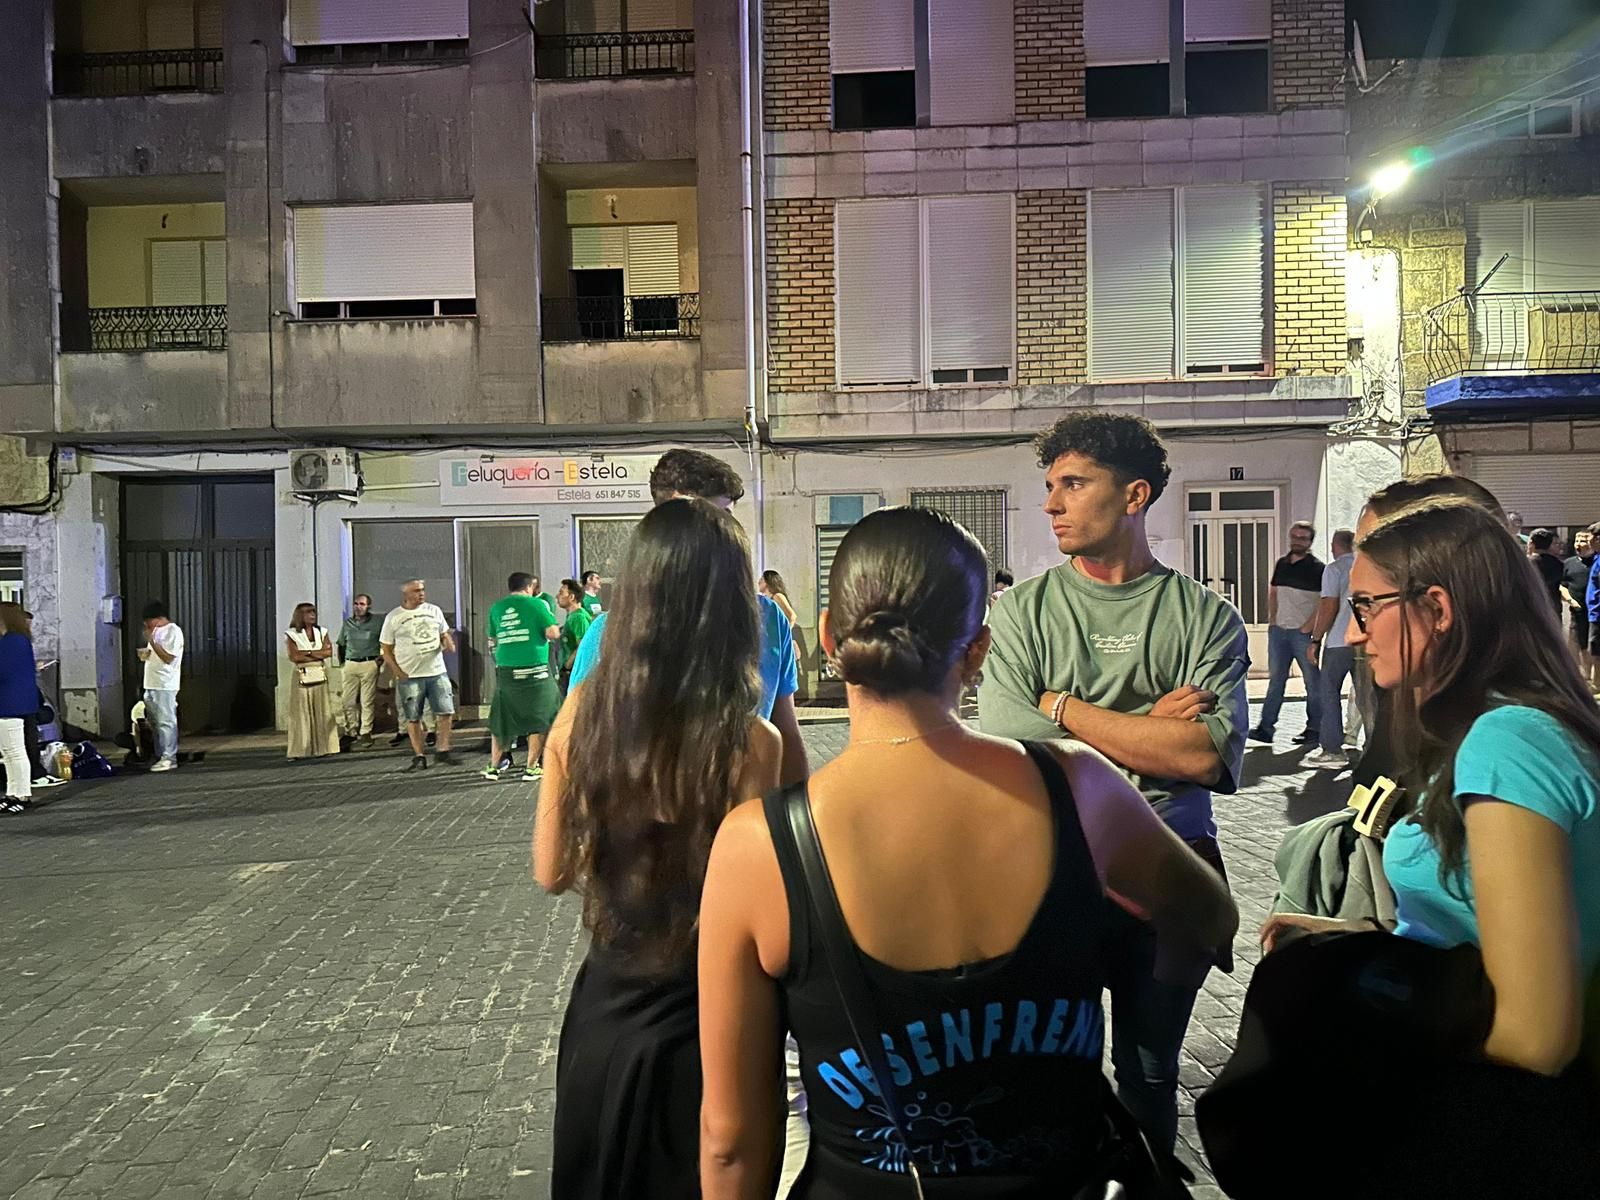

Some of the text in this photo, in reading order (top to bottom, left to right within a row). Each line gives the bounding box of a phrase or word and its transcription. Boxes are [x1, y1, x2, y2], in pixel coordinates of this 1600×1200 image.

[456, 462, 550, 485] Peluquería
[568, 462, 628, 480] Estela
[1231, 468, 1243, 480] 17
[557, 489, 641, 501] Estela 651 847 515
